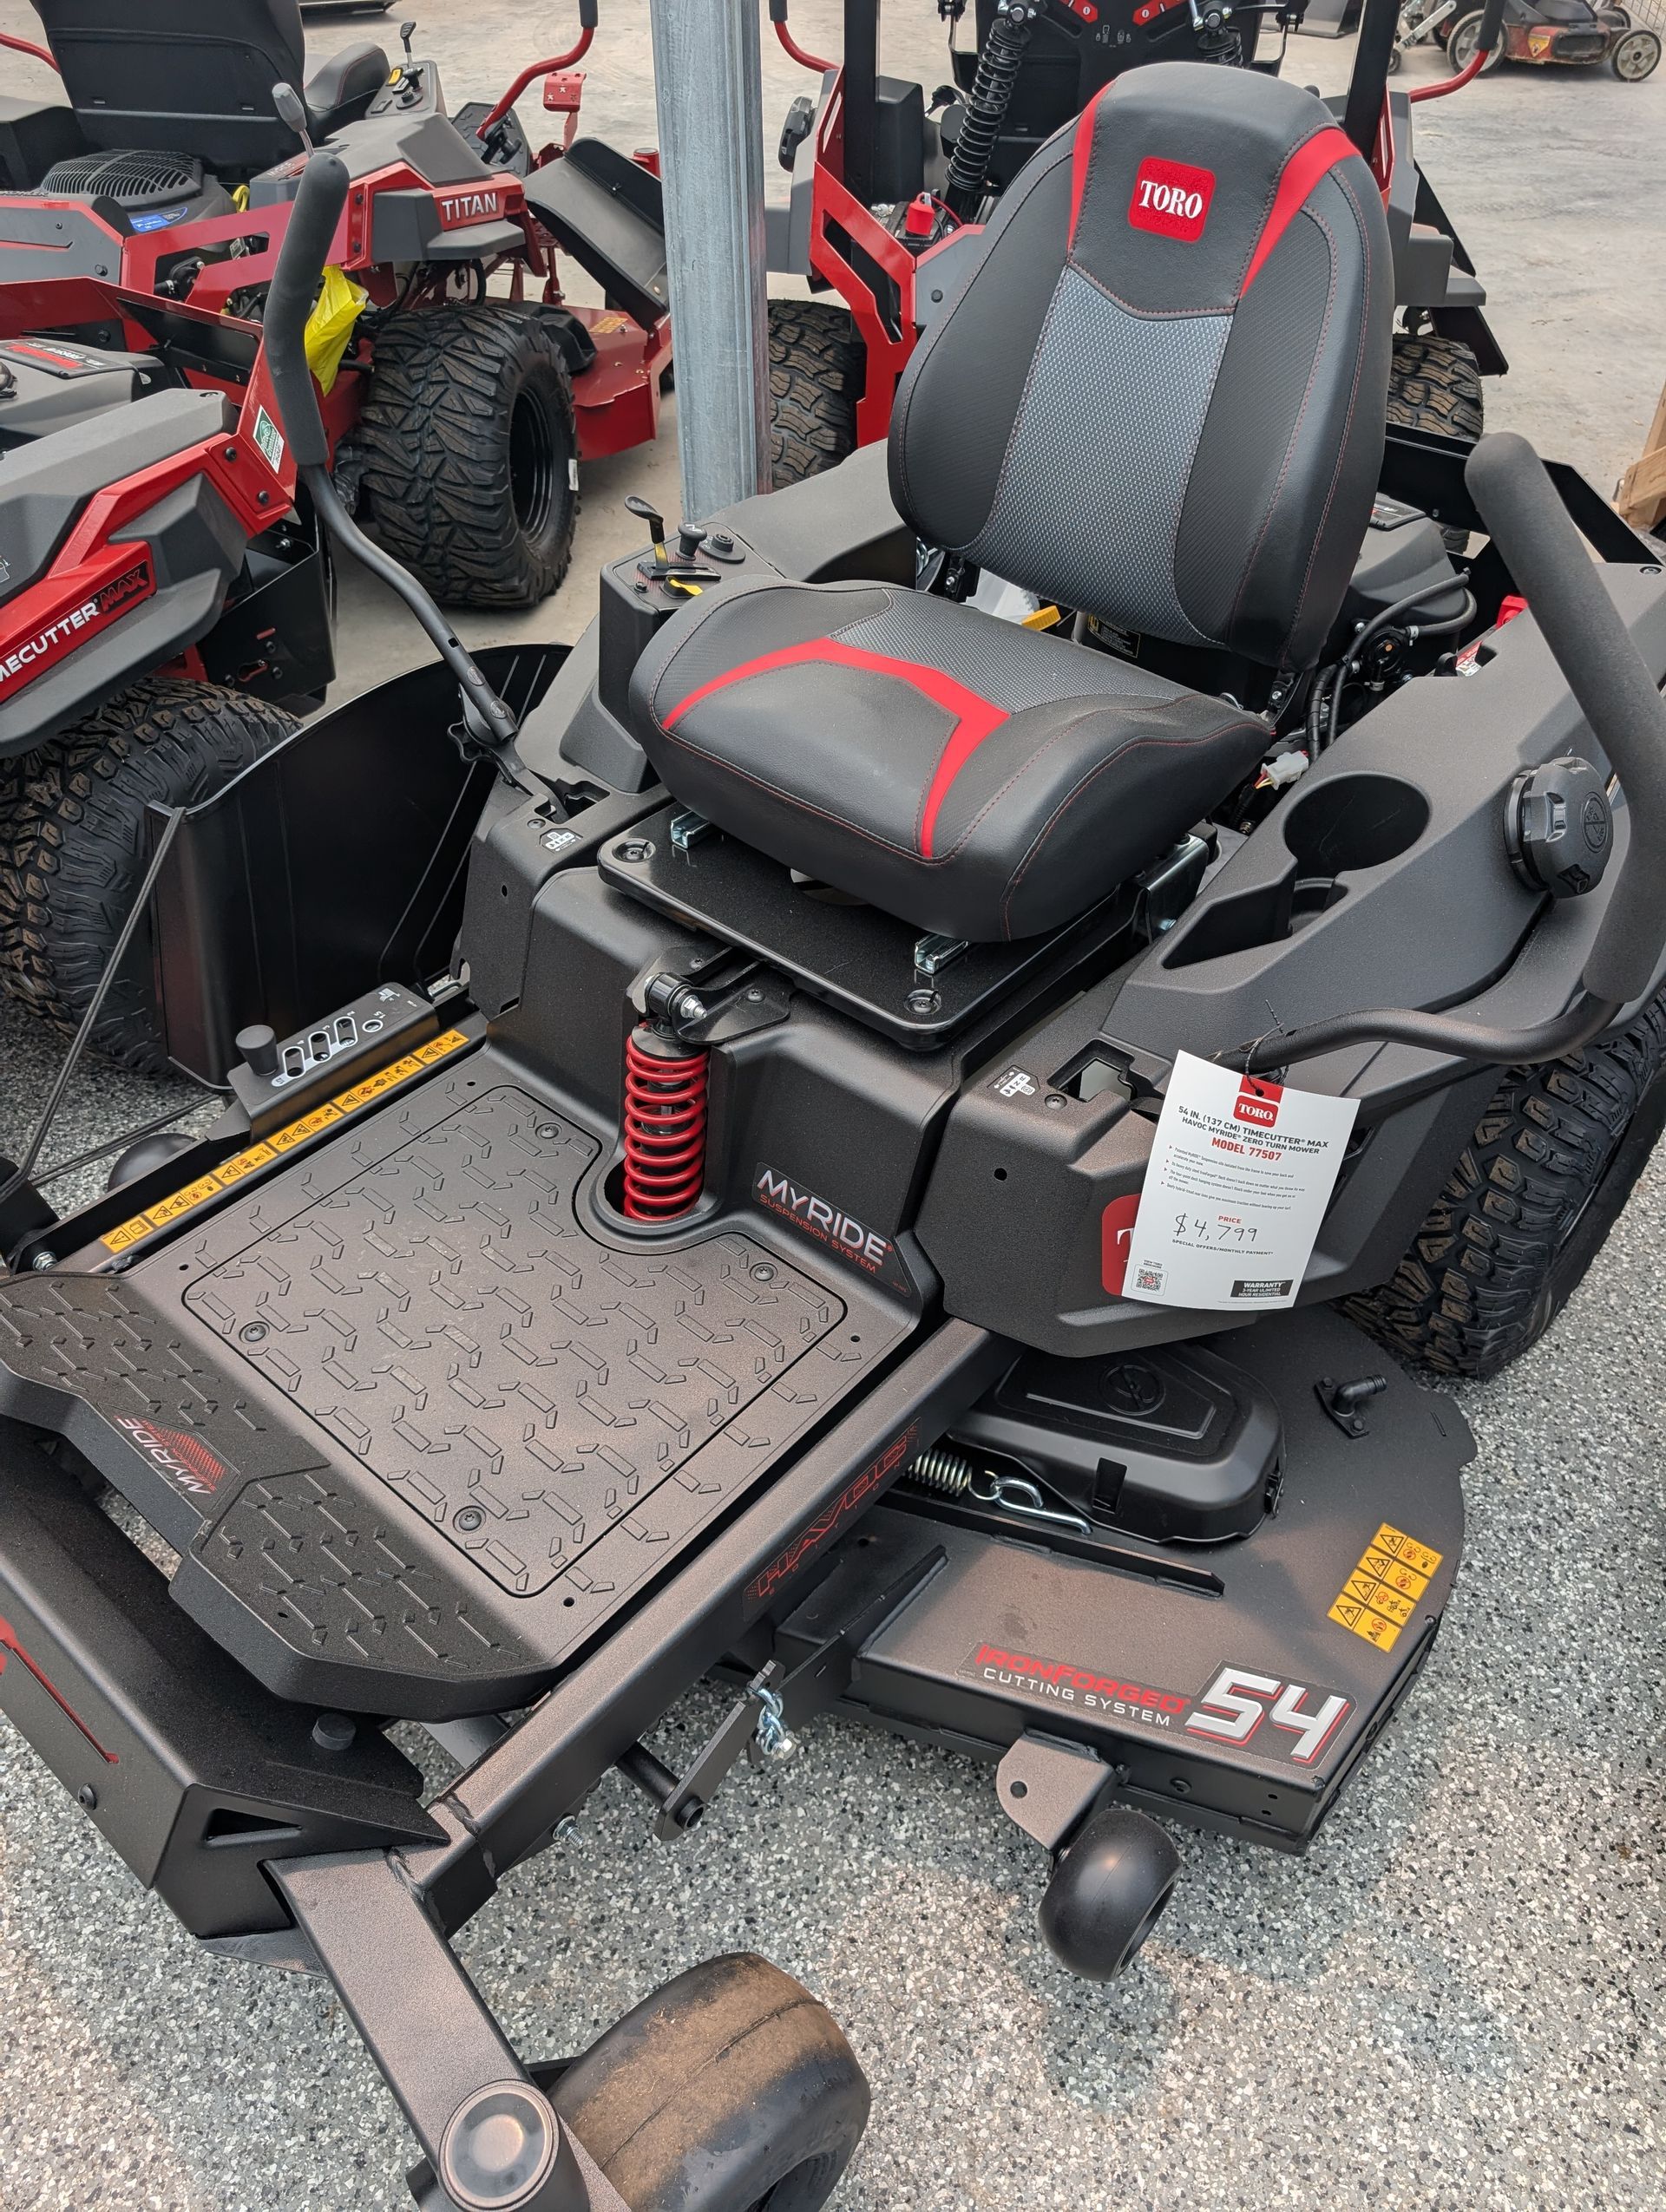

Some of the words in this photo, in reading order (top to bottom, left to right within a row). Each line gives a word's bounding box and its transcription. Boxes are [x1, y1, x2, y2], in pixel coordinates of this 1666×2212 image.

[441, 192, 497, 222] TITAN
[1138, 180, 1203, 219] TORO
[99, 568, 148, 612] MAX
[1178, 1105, 1190, 1116] 54
[1190, 1109, 1201, 1121] IN.
[1203, 1114, 1223, 1128] (137
[1223, 1122, 1242, 1133] CM)
[1307, 1139, 1329, 1149] MAX
[1182, 1116, 1207, 1131] HAVOC
[1243, 1135, 1263, 1147] ZERO
[1266, 1140, 1287, 1150] TURN
[1288, 1144, 1320, 1155] MOWER
[1211, 1137, 1245, 1155] MODEL
[1249, 1147, 1282, 1162] 77507
[759, 1194, 828, 1241] SUSPENSION
[831, 1239, 876, 1274] SYSTEM
[1218, 1215, 1242, 1224] PRICE
[1172, 1239, 1195, 1247] SPECIAL
[758, 1435, 908, 1597] HAVOC
[983, 1667, 1075, 1701] CUTTING
[1085, 1694, 1171, 1726] SYSTEM
[1184, 1667, 1350, 1764] 54
